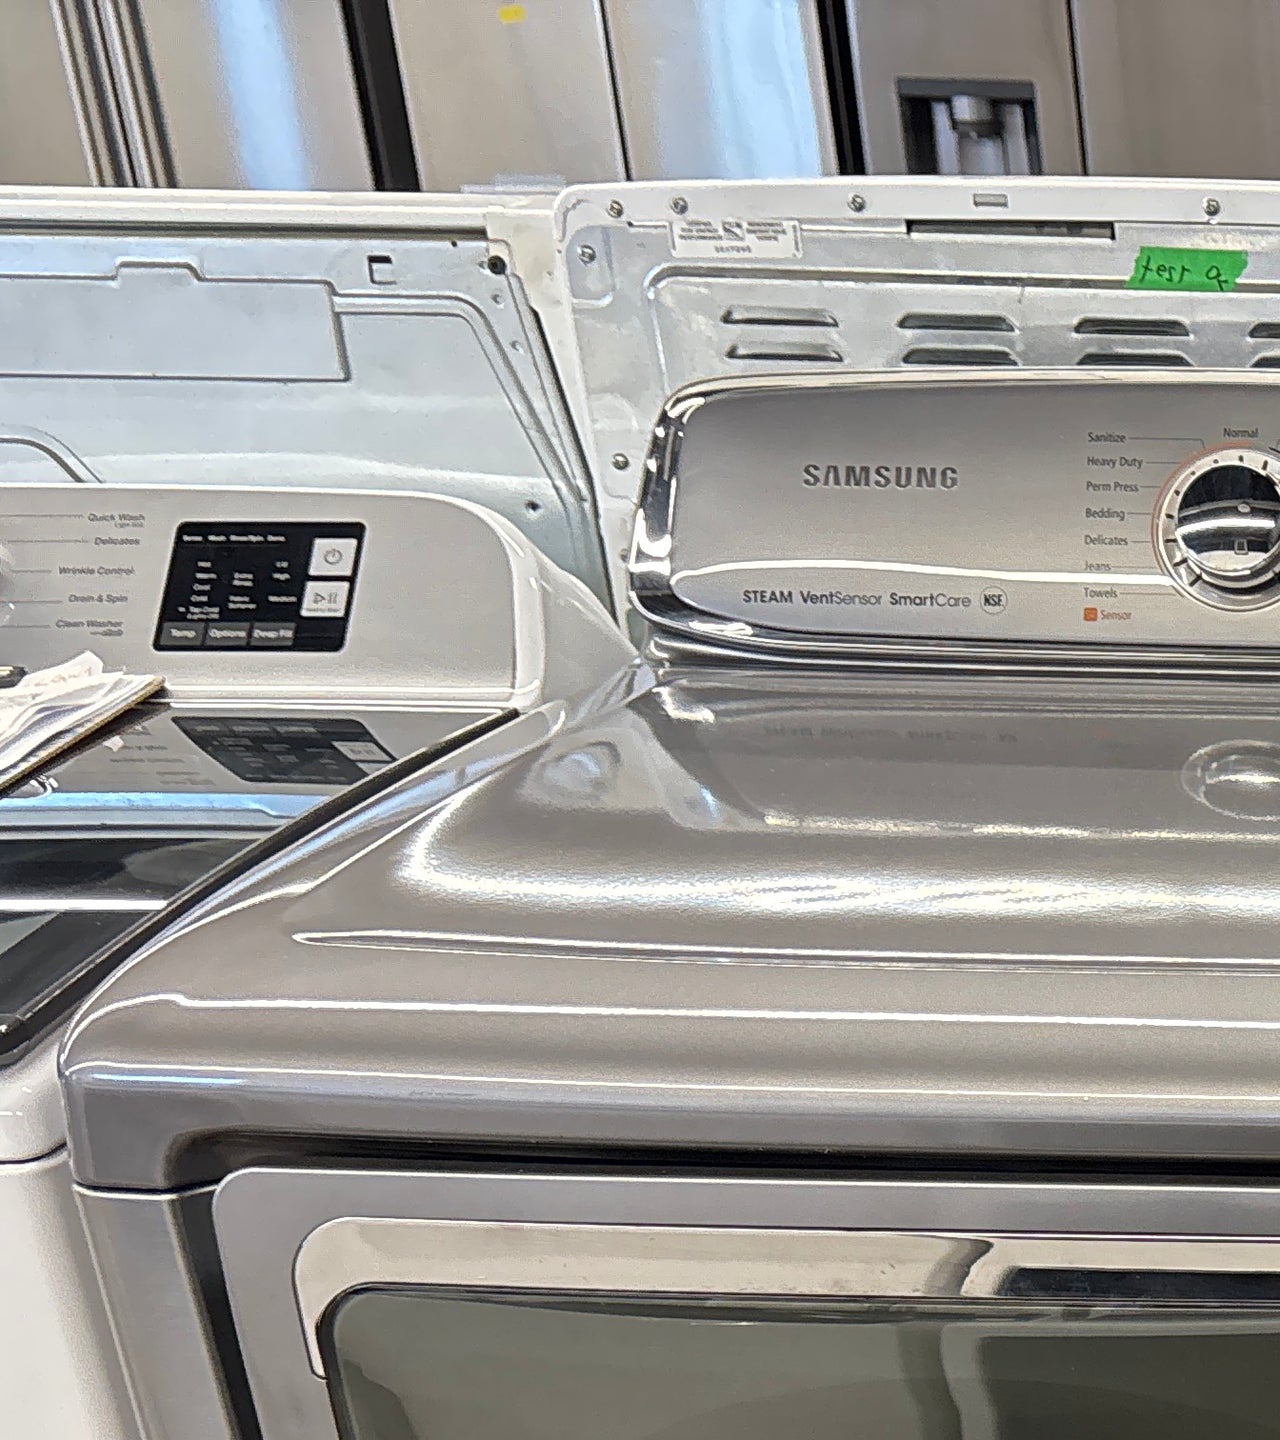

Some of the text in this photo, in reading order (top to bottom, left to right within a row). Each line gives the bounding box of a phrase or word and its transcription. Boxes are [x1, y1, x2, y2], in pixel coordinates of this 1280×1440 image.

[1087, 432, 1126, 444] Sanitize
[1223, 427, 1258, 438] Normal
[1087, 456, 1143, 469] Heavy Duty
[803, 464, 958, 489] SAMSUNG
[1086, 482, 1139, 493] Perm Press
[88, 513, 114, 522] Quick
[1085, 508, 1125, 521] Bedding
[94, 537, 140, 545] Delicates
[1084, 534, 1128, 546] Delicates
[58, 566, 134, 575] Wrinkle Control
[1083, 561, 1111, 572] Jeans
[68, 594, 128, 604] Drain & Spin
[742, 590, 792, 604] STEAM
[799, 591, 882, 606] VentSensor
[889, 592, 972, 607] SmartCare
[1083, 588, 1118, 599] Towels
[1100, 609, 1132, 621] Sensor
[56, 619, 124, 628] Clean Washer
